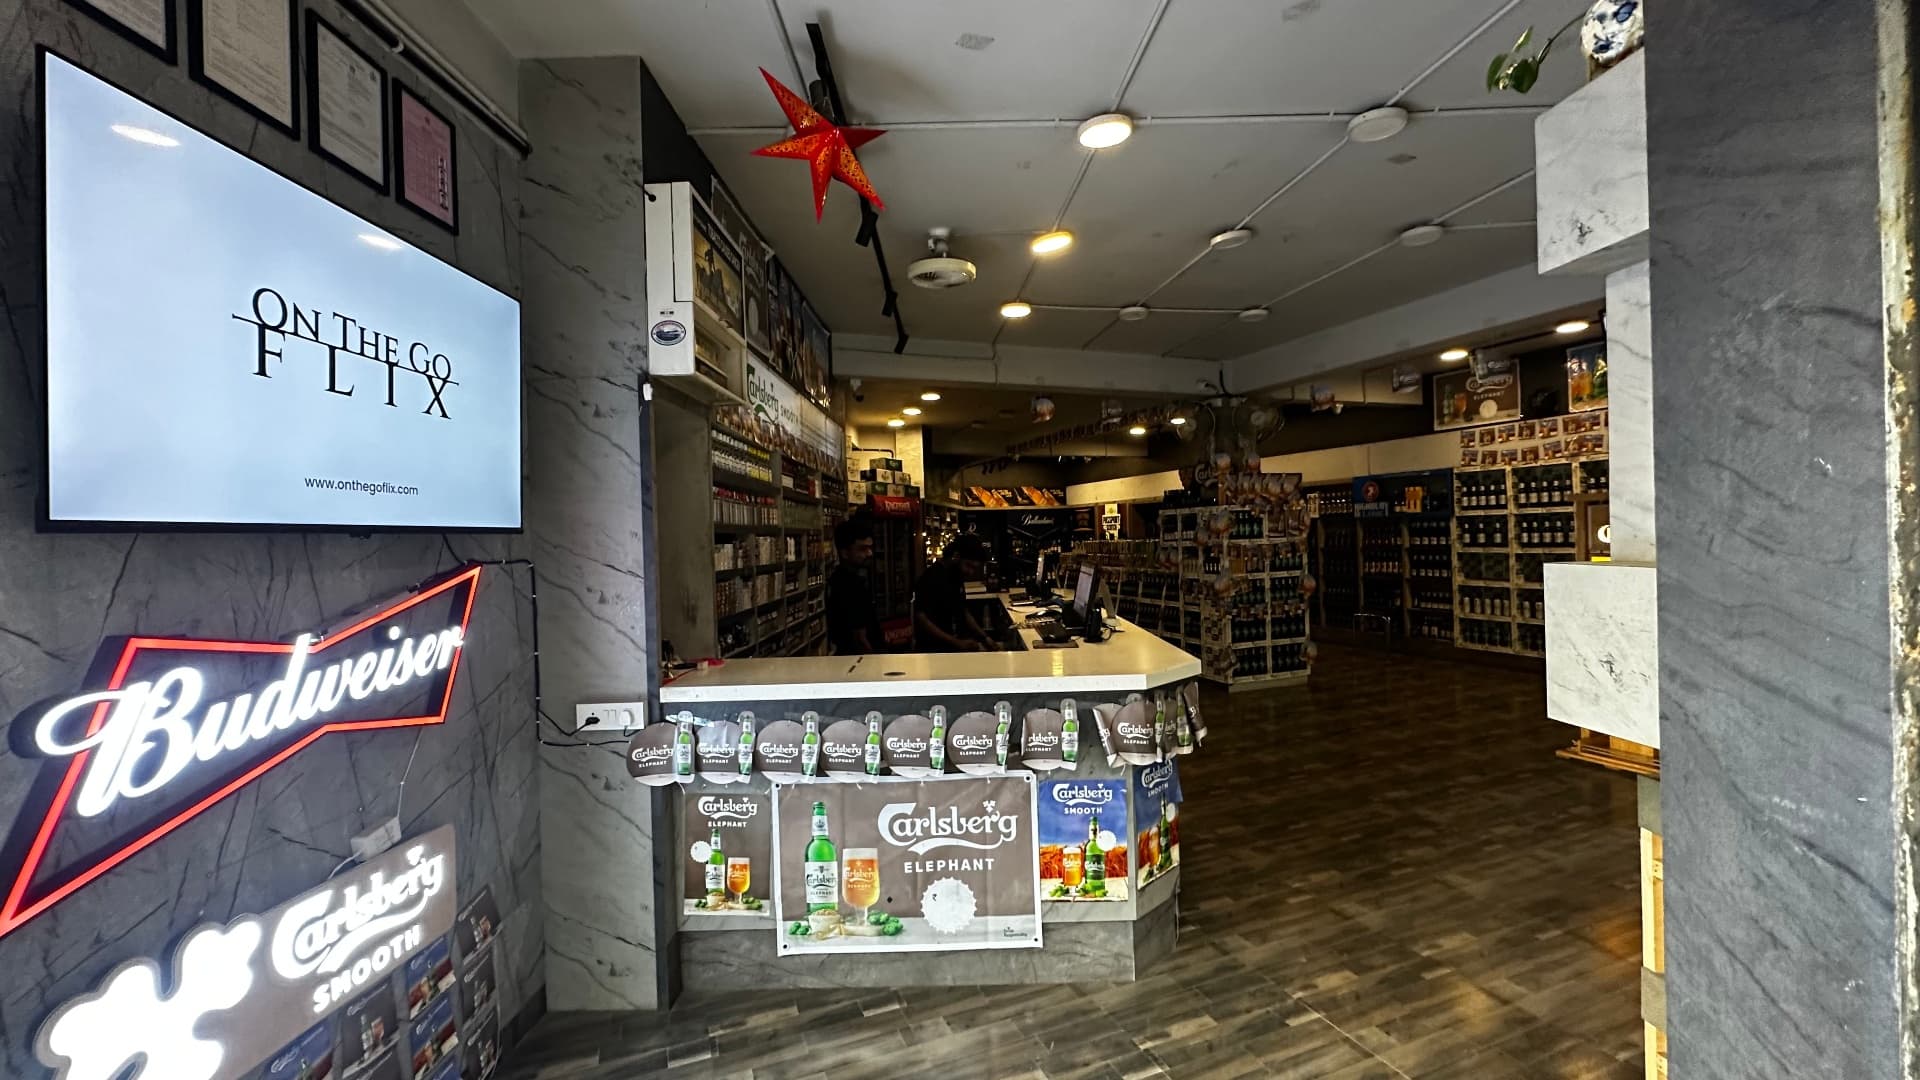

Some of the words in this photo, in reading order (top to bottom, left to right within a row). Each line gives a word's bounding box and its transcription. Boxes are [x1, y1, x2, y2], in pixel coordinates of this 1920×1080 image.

[252, 287, 322, 342] ON
[332, 311, 400, 366] THE
[409, 342, 452, 381] GO
[304, 477, 419, 496] www.onthegoflix.com
[35, 626, 465, 817] Budweiser
[1117, 722, 1154, 738] Carlsberg
[886, 737, 927, 753] Carlsberg
[952, 734, 993, 750] Carlsberg
[1027, 731, 1059, 746] rlsberg
[631, 744, 674, 762] Carlsberg
[697, 742, 736, 758] Carlsberg
[759, 742, 799, 758] Carlsberg
[822, 742, 862, 758] Carlsberg
[1141, 759, 1173, 788] Carlsberg
[1052, 783, 1113, 806] Carlsberg
[697, 796, 758, 819] Carlsberg
[1064, 807, 1103, 815] SMOOTH
[707, 820, 748, 828] ELEPHANT
[877, 800, 1019, 855] Carlsberg
[903, 857, 996, 874] ELEPHANT
[271, 845, 446, 980] Carlsberg
[311, 923, 423, 1014] SMOOTH
